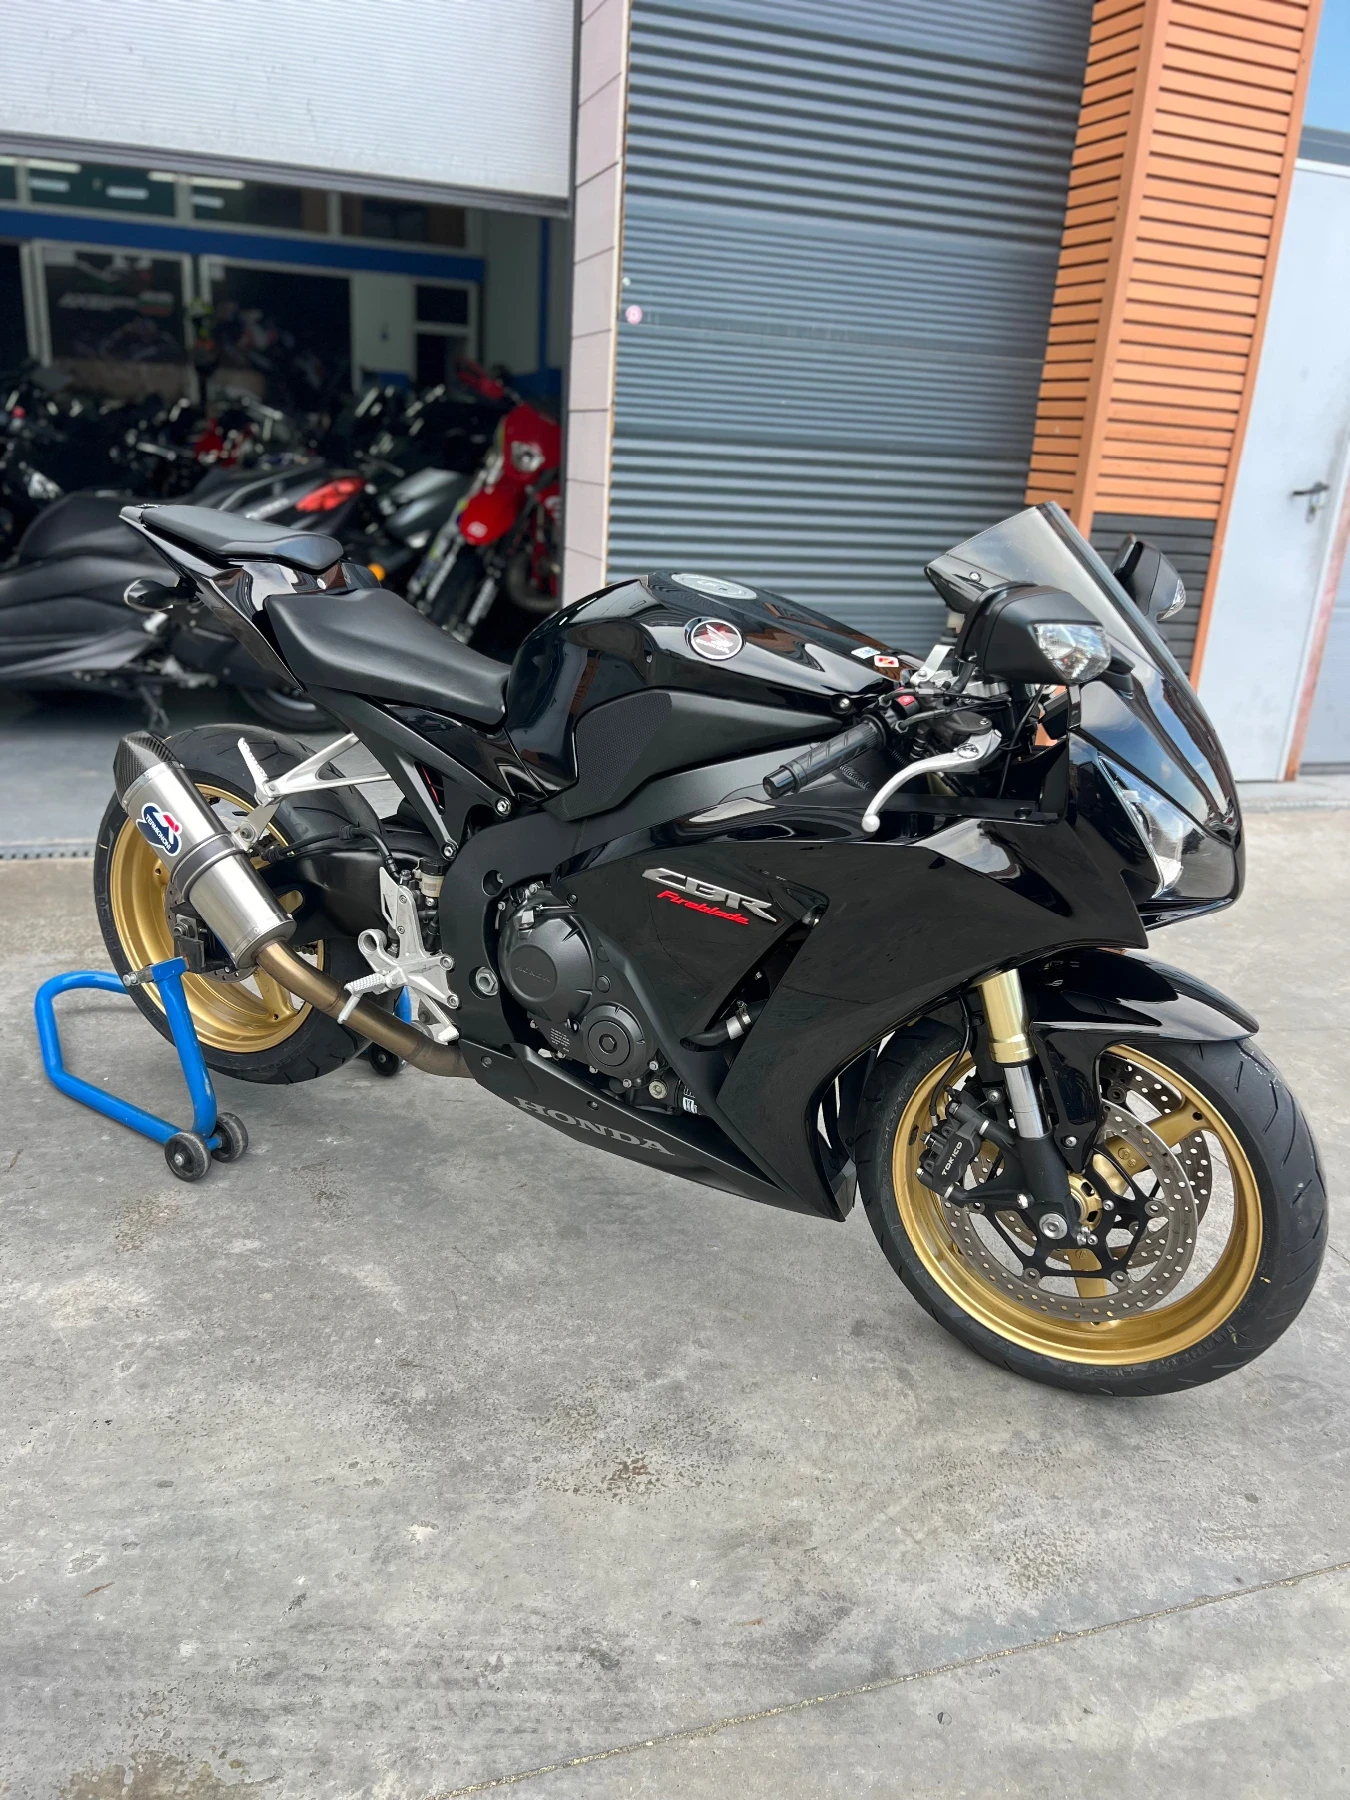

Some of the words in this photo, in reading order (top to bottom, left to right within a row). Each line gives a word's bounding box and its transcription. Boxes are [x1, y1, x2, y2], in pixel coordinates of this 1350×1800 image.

[145, 813, 172, 851] TERMIGNONI
[642, 867, 777, 922] CBR
[656, 890, 749, 925] Fireblade
[513, 1096, 675, 1156] HONDA
[941, 1141, 963, 1176] TOKICO
